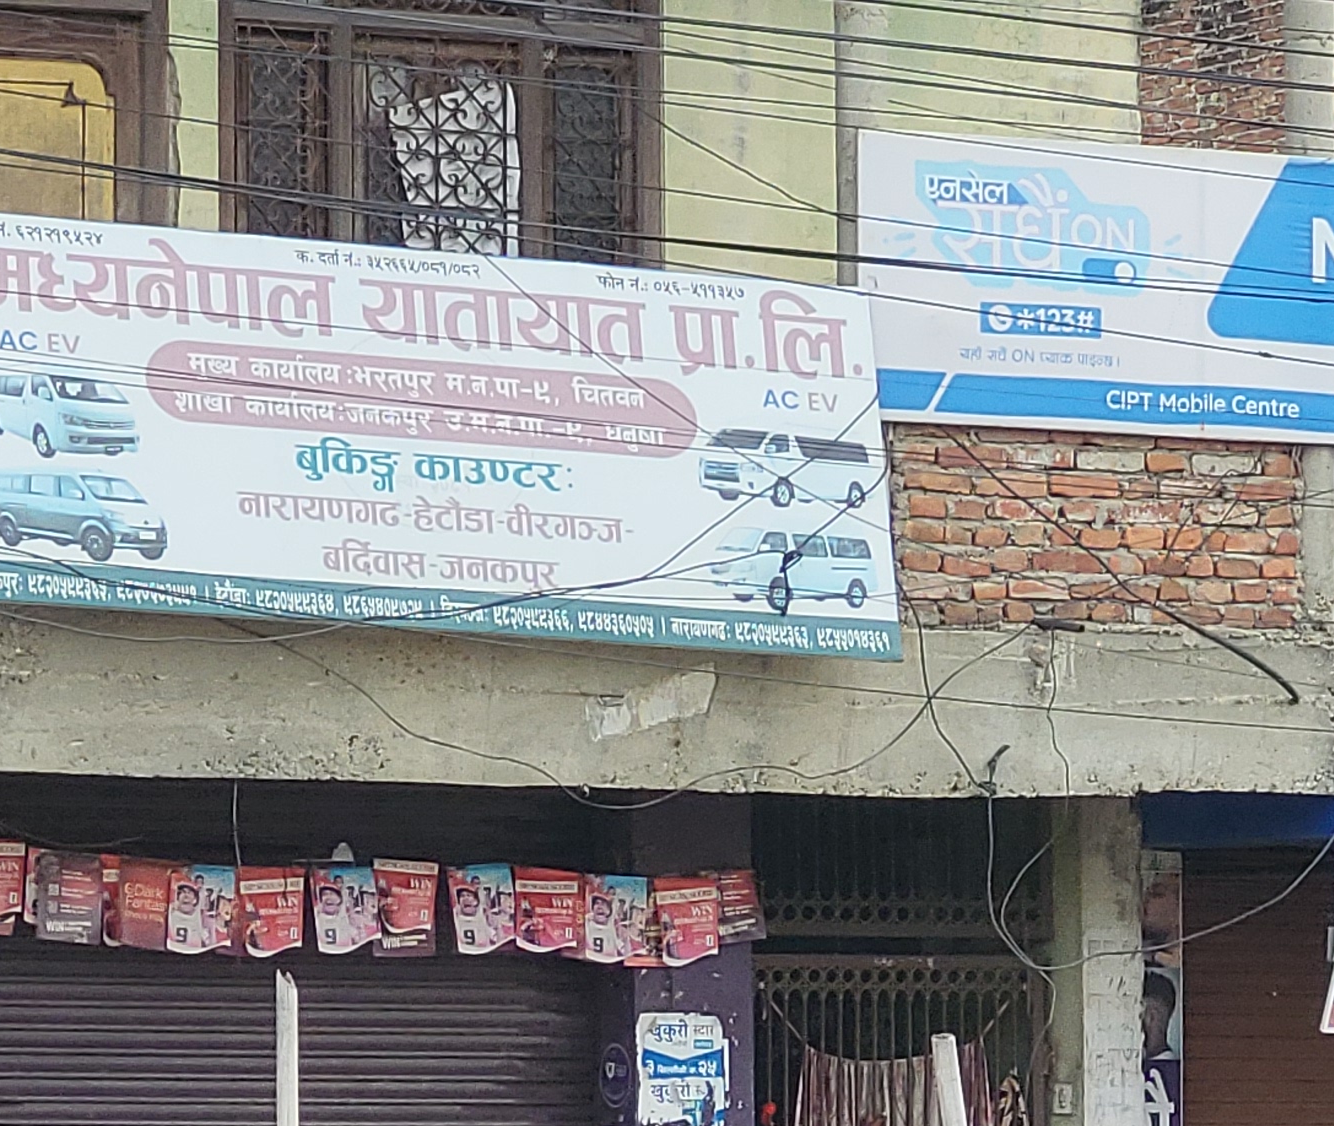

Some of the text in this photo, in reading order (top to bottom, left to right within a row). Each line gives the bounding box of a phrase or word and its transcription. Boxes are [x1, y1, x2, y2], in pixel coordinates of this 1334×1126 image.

[923, 168, 1010, 206] एनसेल
[1071, 212, 1136, 252] ON
[596, 271, 625, 291] फोन
[0, 329, 82, 355] AC EV
[358, 277, 646, 365] यातायात
[668, 288, 864, 380] प्रा.लि.
[1011, 349, 1036, 365] ON
[249, 354, 645, 410] कार्यालय चितवन
[763, 388, 840, 414] AC EV
[1106, 388, 1301, 420] CIPT Mobile Centre
[295, 436, 401, 493] बुकिङ्ग
